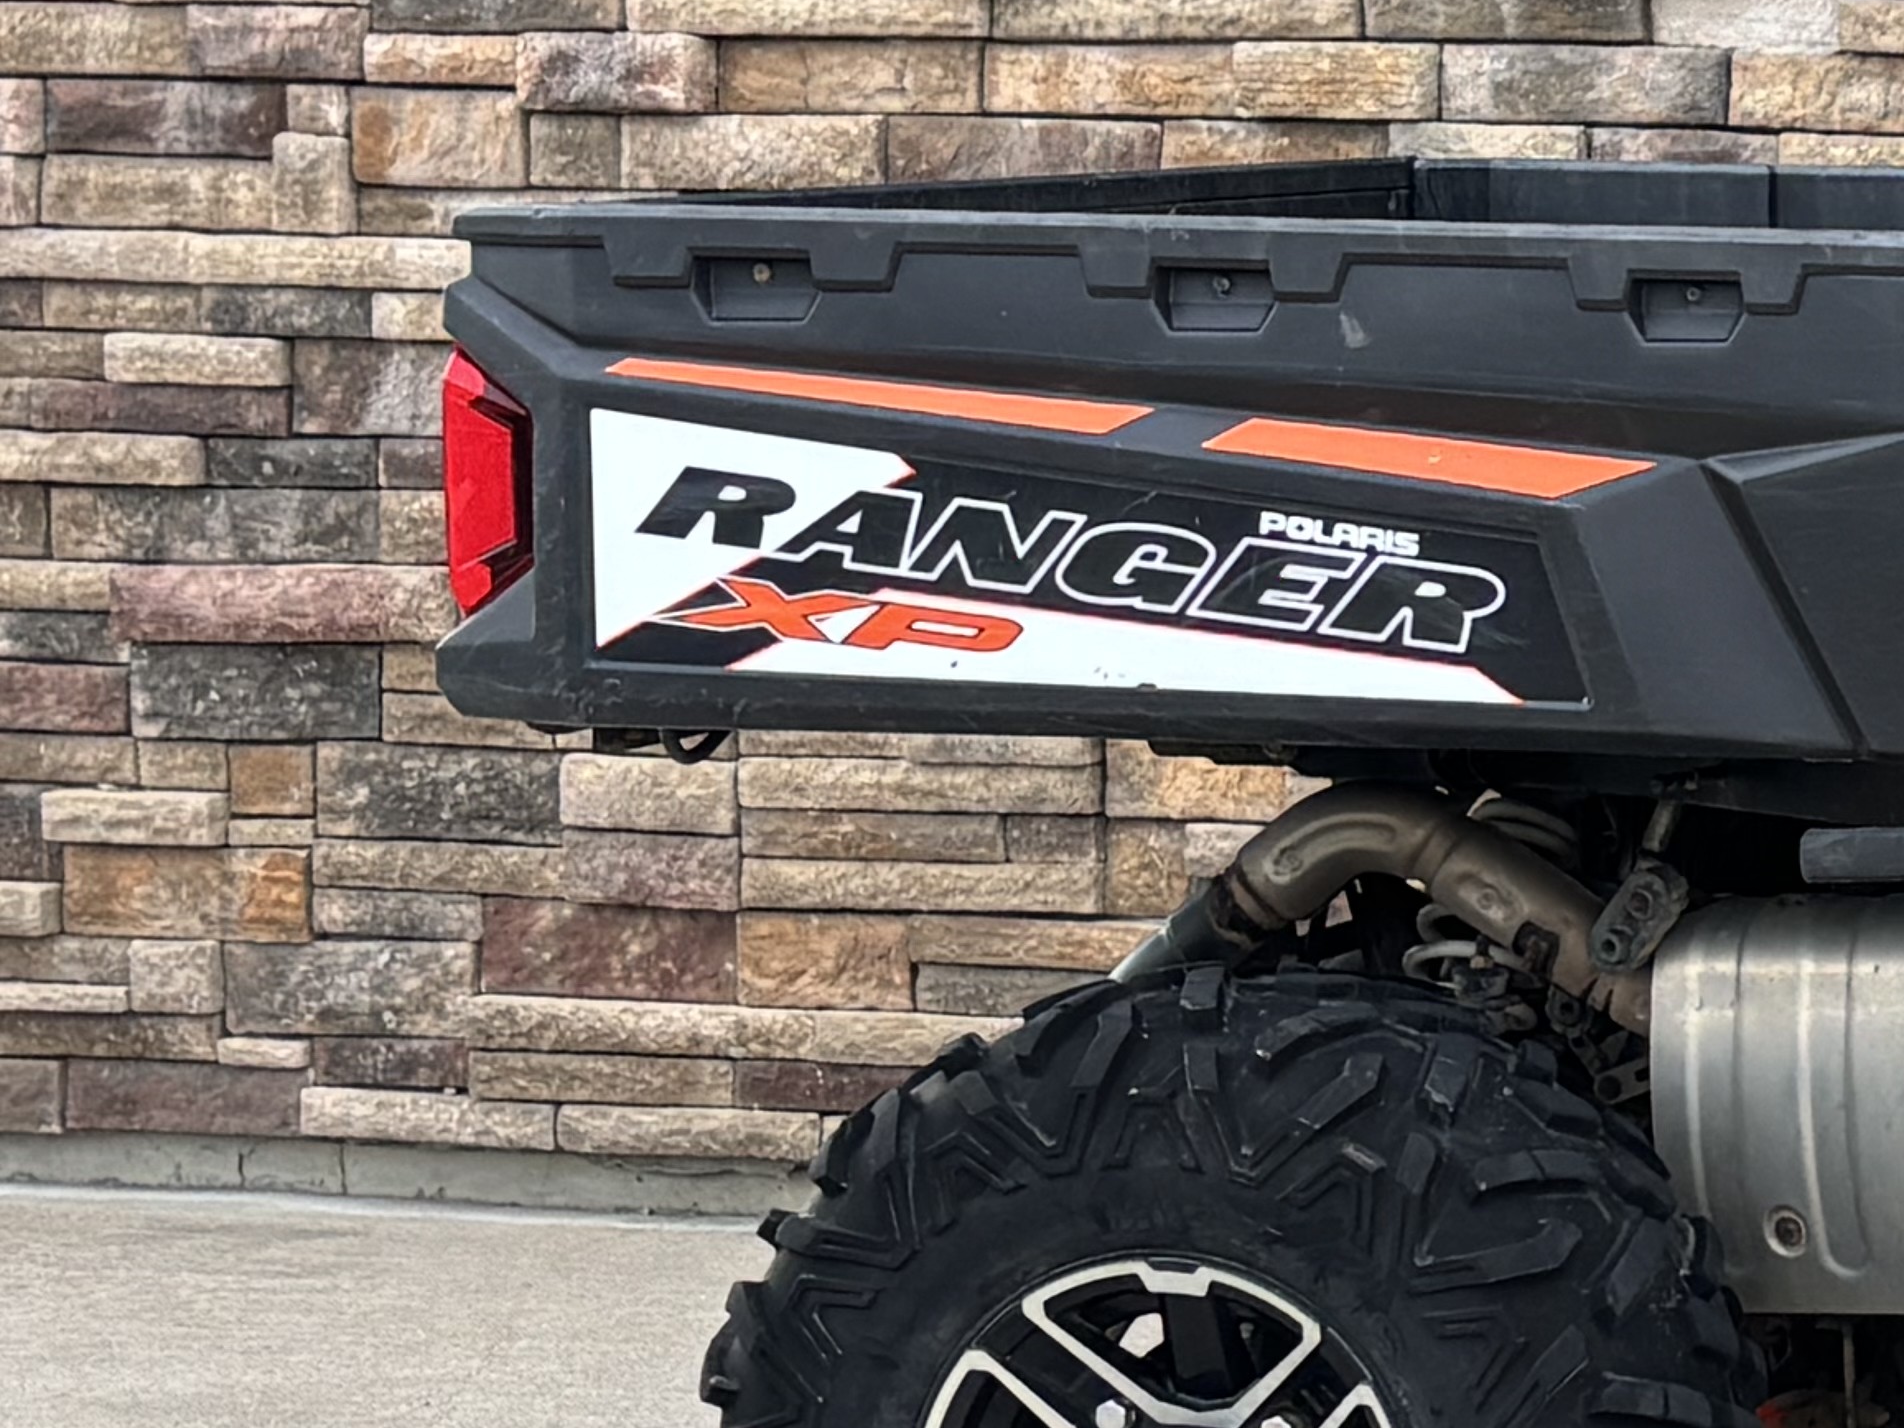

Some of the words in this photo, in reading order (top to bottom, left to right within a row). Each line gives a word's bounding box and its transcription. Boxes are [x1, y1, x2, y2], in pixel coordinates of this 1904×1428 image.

[634, 465, 1507, 655] RANGER
[1259, 511, 1420, 557] POLARIS
[664, 575, 1026, 653] XP
